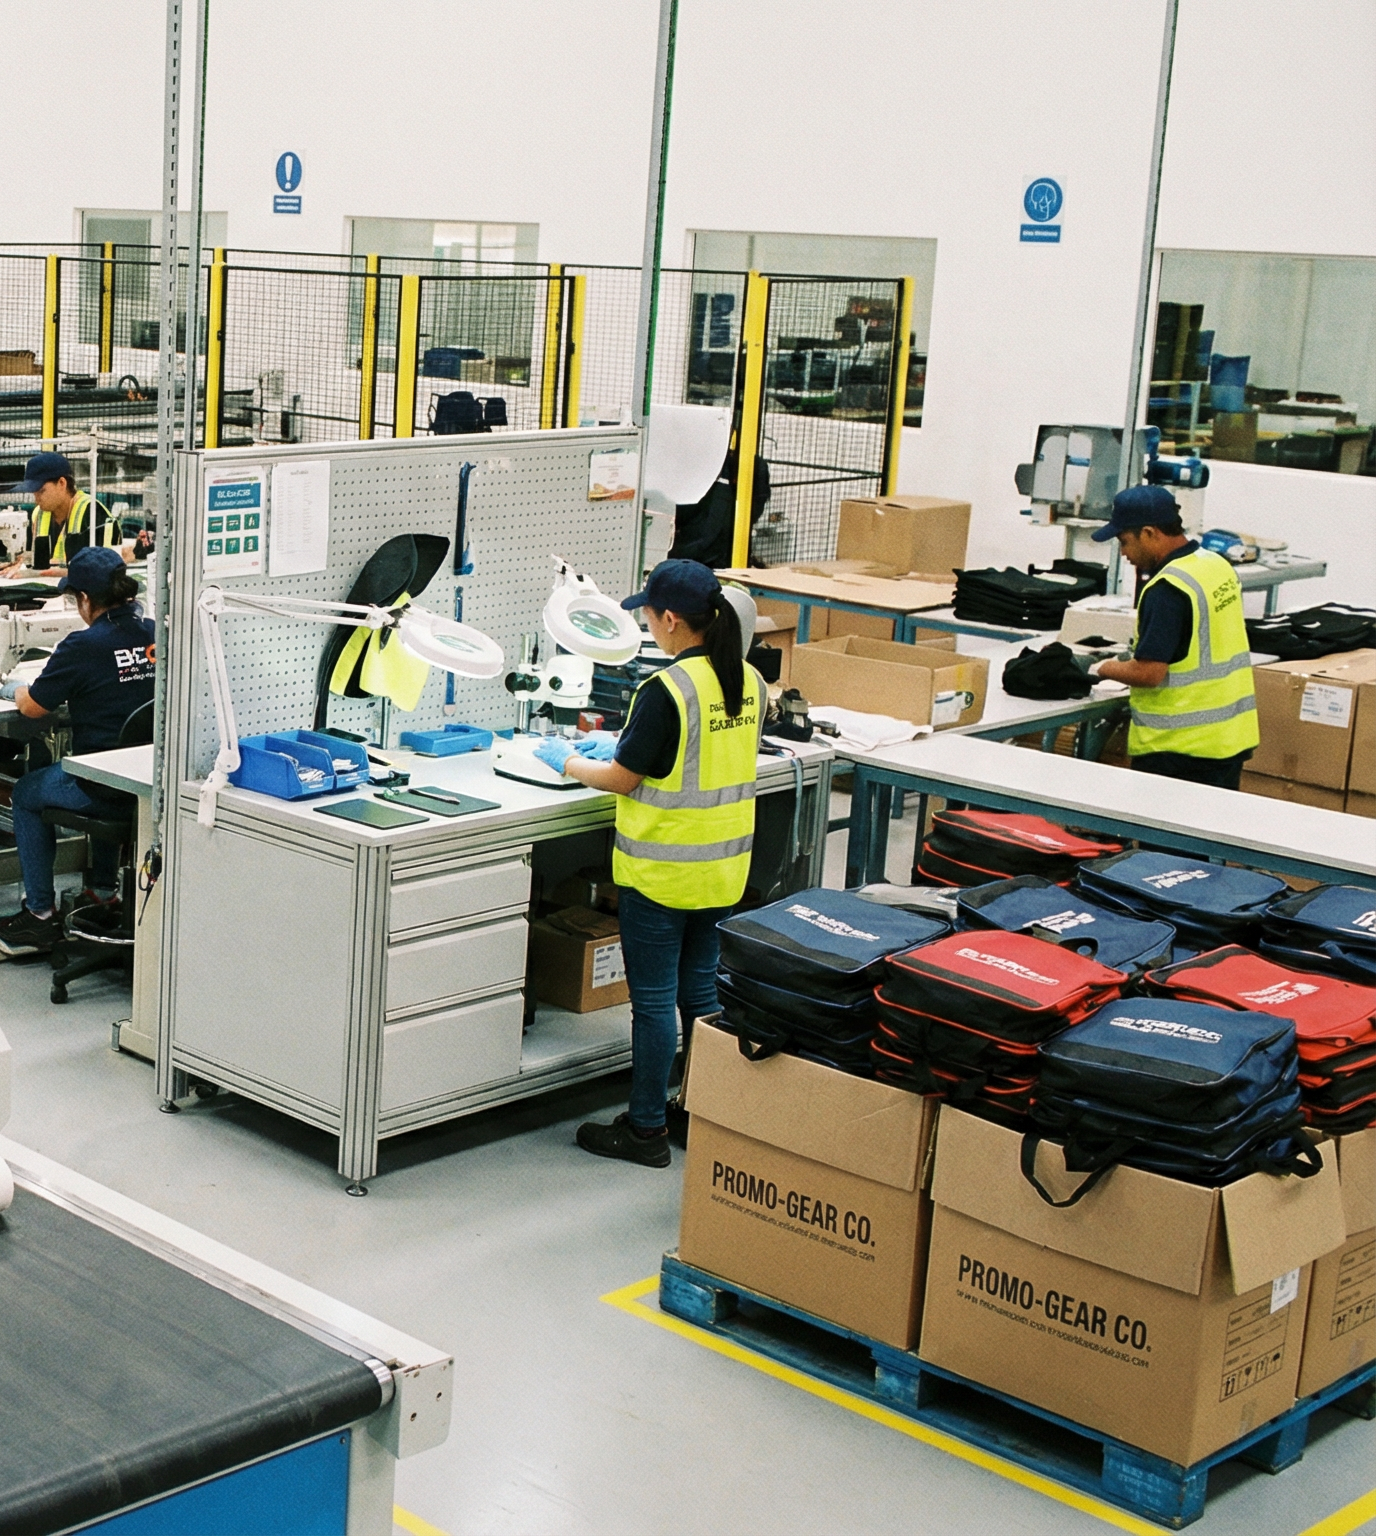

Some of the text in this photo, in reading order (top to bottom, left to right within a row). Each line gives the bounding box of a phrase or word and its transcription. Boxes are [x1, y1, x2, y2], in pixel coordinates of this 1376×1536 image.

[712, 1160, 838, 1234] PROMO-GEAR
[844, 1211, 876, 1247] CO.
[958, 1254, 1107, 1337] PROMO-GEAR
[1114, 1315, 1152, 1353] CO.
